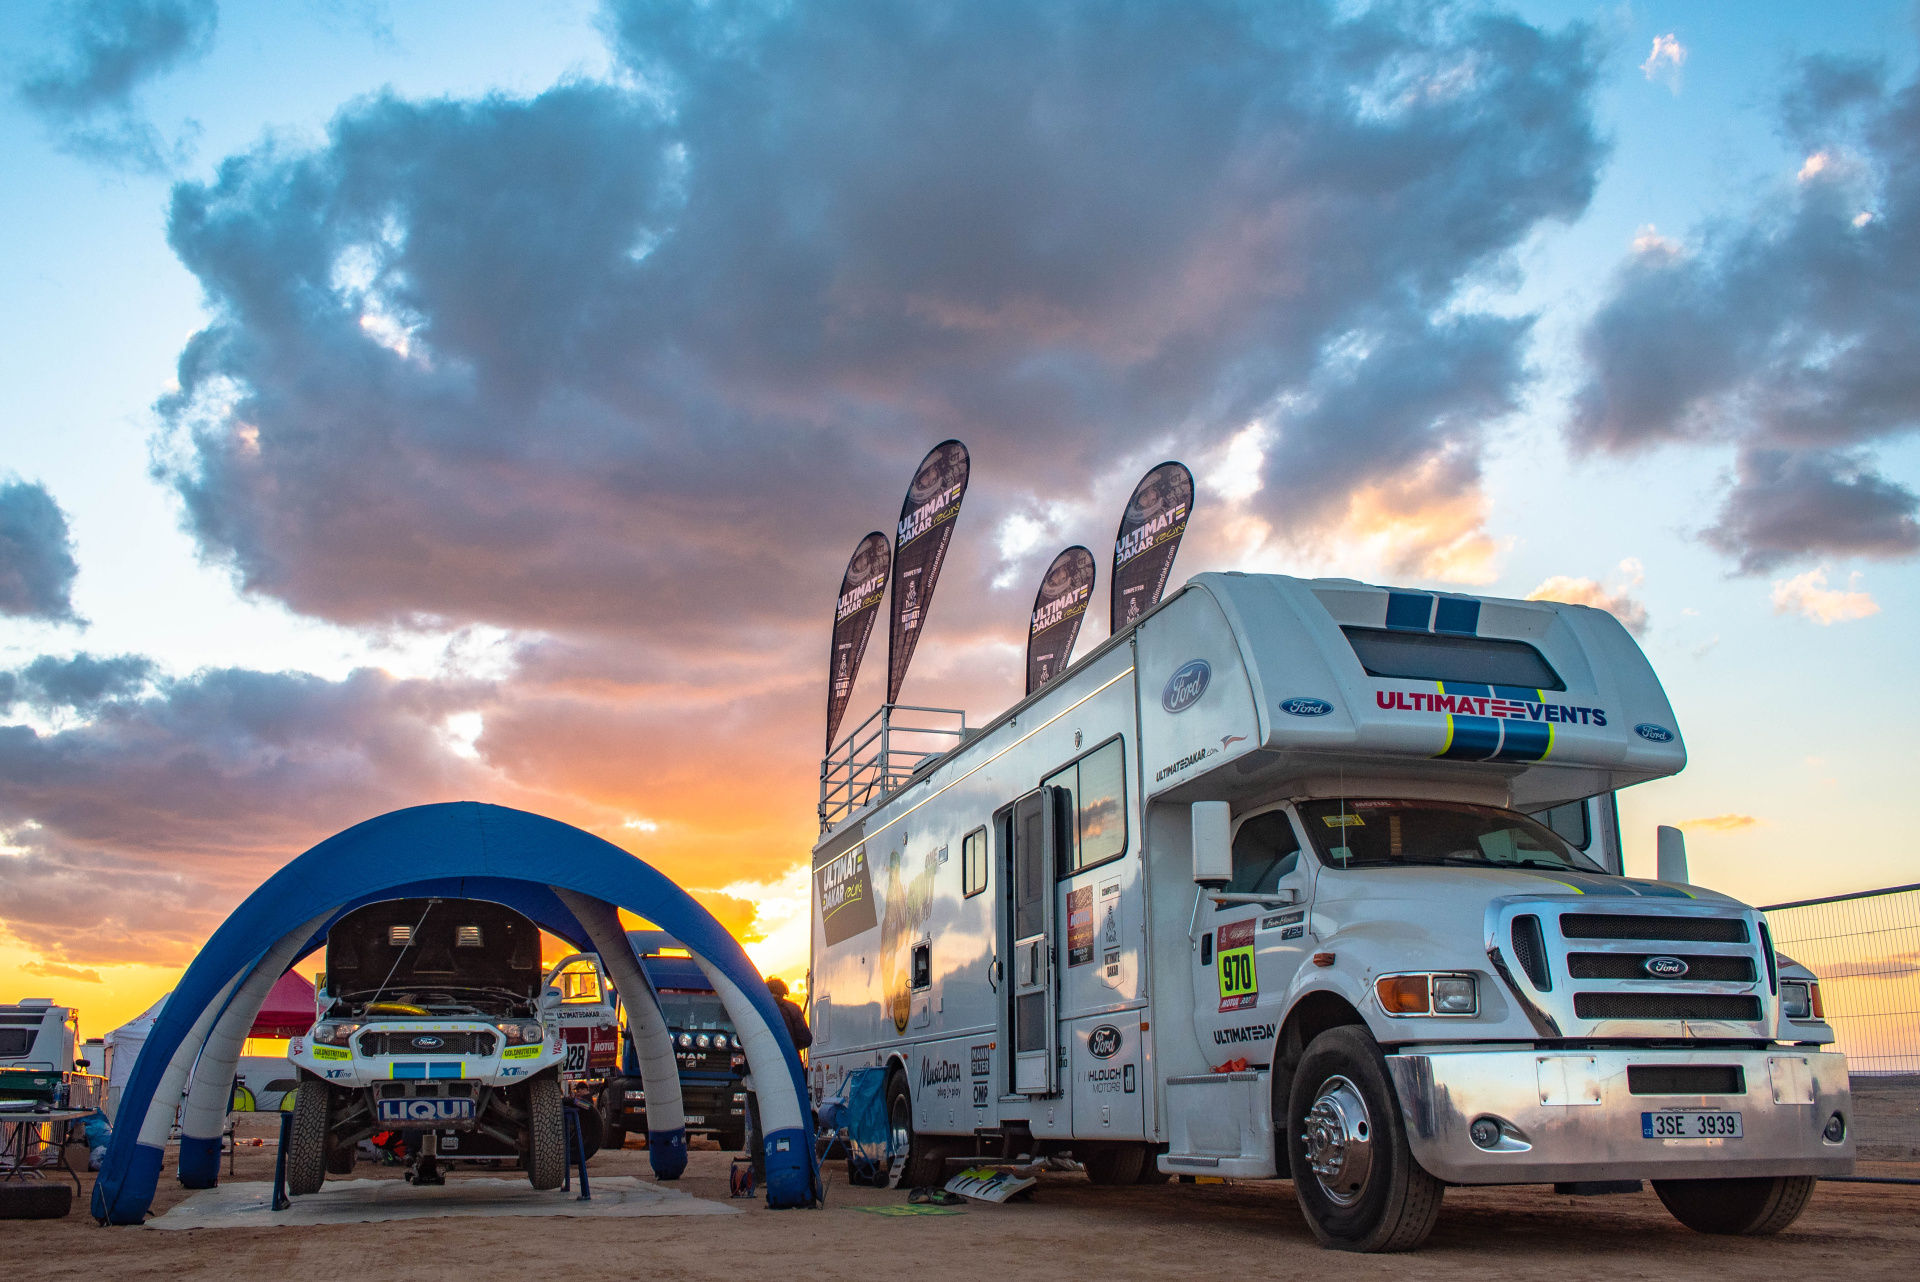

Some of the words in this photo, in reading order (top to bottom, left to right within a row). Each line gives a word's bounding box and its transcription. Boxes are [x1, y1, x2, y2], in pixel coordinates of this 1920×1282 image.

[898, 482, 961, 534] ULTIMATE
[898, 516, 932, 547] DAKAR
[1115, 502, 1187, 555] ULTIMATE
[1116, 535, 1154, 566] DAKAR
[1151, 545, 1177, 605] ultimatedakar.com
[837, 572, 885, 611] ULTIMATE
[837, 599, 862, 621] DAKAR
[1032, 584, 1089, 624] ULTIMATE
[1032, 610, 1063, 634] DAKAR
[1170, 669, 1203, 708] Ford
[1289, 700, 1325, 715] Ford
[1223, 953, 1252, 992] 970
[1656, 960, 1679, 972] Ford
[594, 1041, 615, 1052] MOTUL
[1093, 1030, 1116, 1054] Ford
[676, 1052, 707, 1060] MAN
[1088, 1068, 1122, 1082] HLOUCH
[973, 1085, 989, 1103] OMP
[1092, 1081, 1121, 1094] MOTORS
[383, 1101, 470, 1119] LIQUI
[1655, 1115, 1686, 1135] 3SE
[1696, 1115, 1736, 1135] 3939
